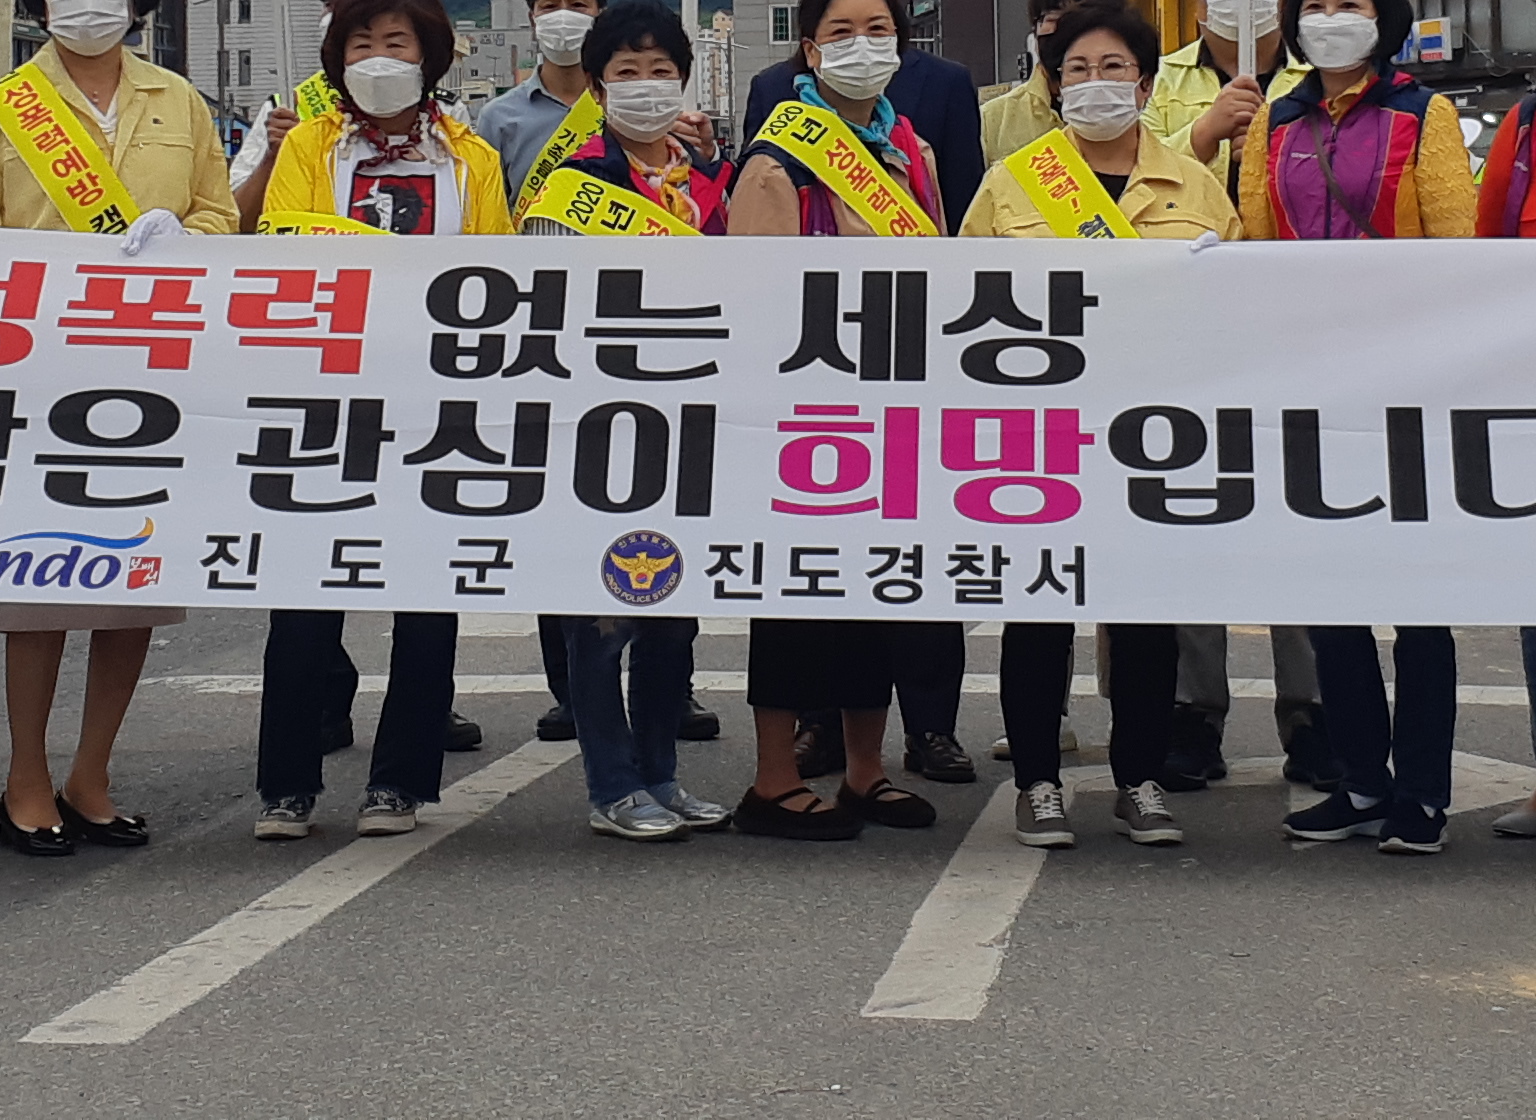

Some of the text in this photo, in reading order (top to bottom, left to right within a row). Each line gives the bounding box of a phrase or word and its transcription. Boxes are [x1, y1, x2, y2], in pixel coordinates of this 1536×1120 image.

[2, 80, 106, 207] 성폭력예방
[426, 267, 729, 381] 없는
[779, 271, 1098, 385] 세상
[237, 397, 716, 517] 관심이
[621, 591, 651, 603] POLICE
[652, 572, 678, 600] STATION
[705, 543, 1085, 606] 진도경찰서
